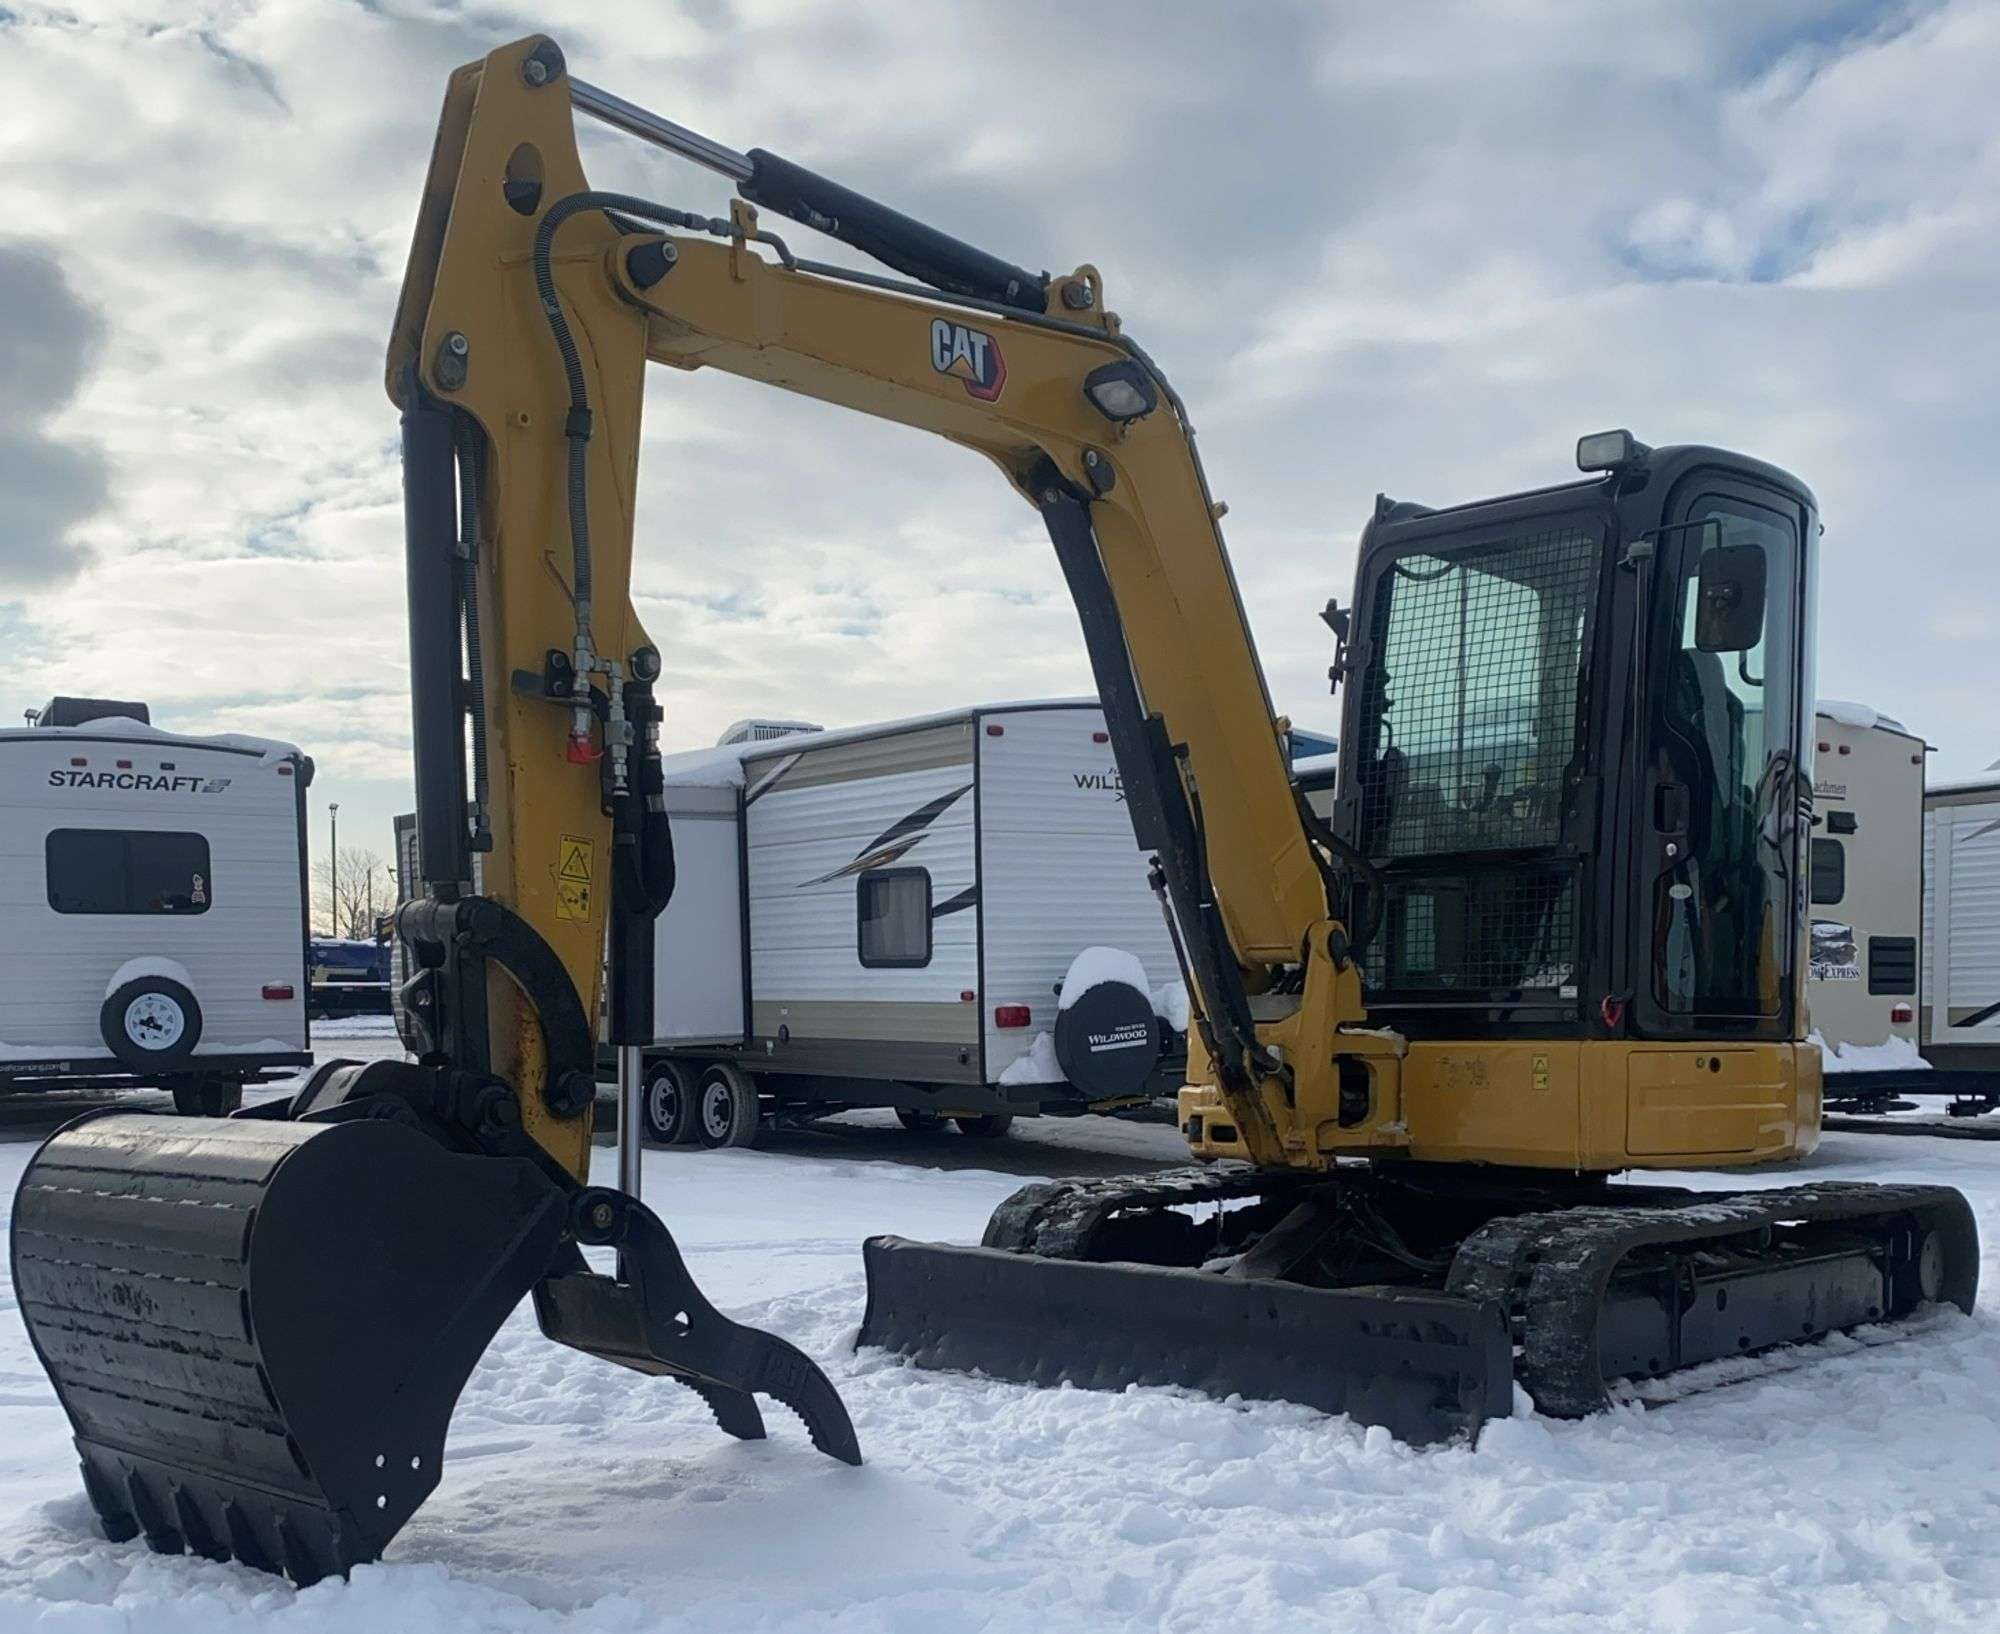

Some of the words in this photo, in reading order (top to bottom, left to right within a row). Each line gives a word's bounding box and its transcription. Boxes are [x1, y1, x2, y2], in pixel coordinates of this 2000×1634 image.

[930, 318, 988, 384] CAT
[48, 770, 204, 793] STARCRAFT
[1073, 774, 1124, 790] WILD
[1088, 1029, 1148, 1045] WILDWOOD
